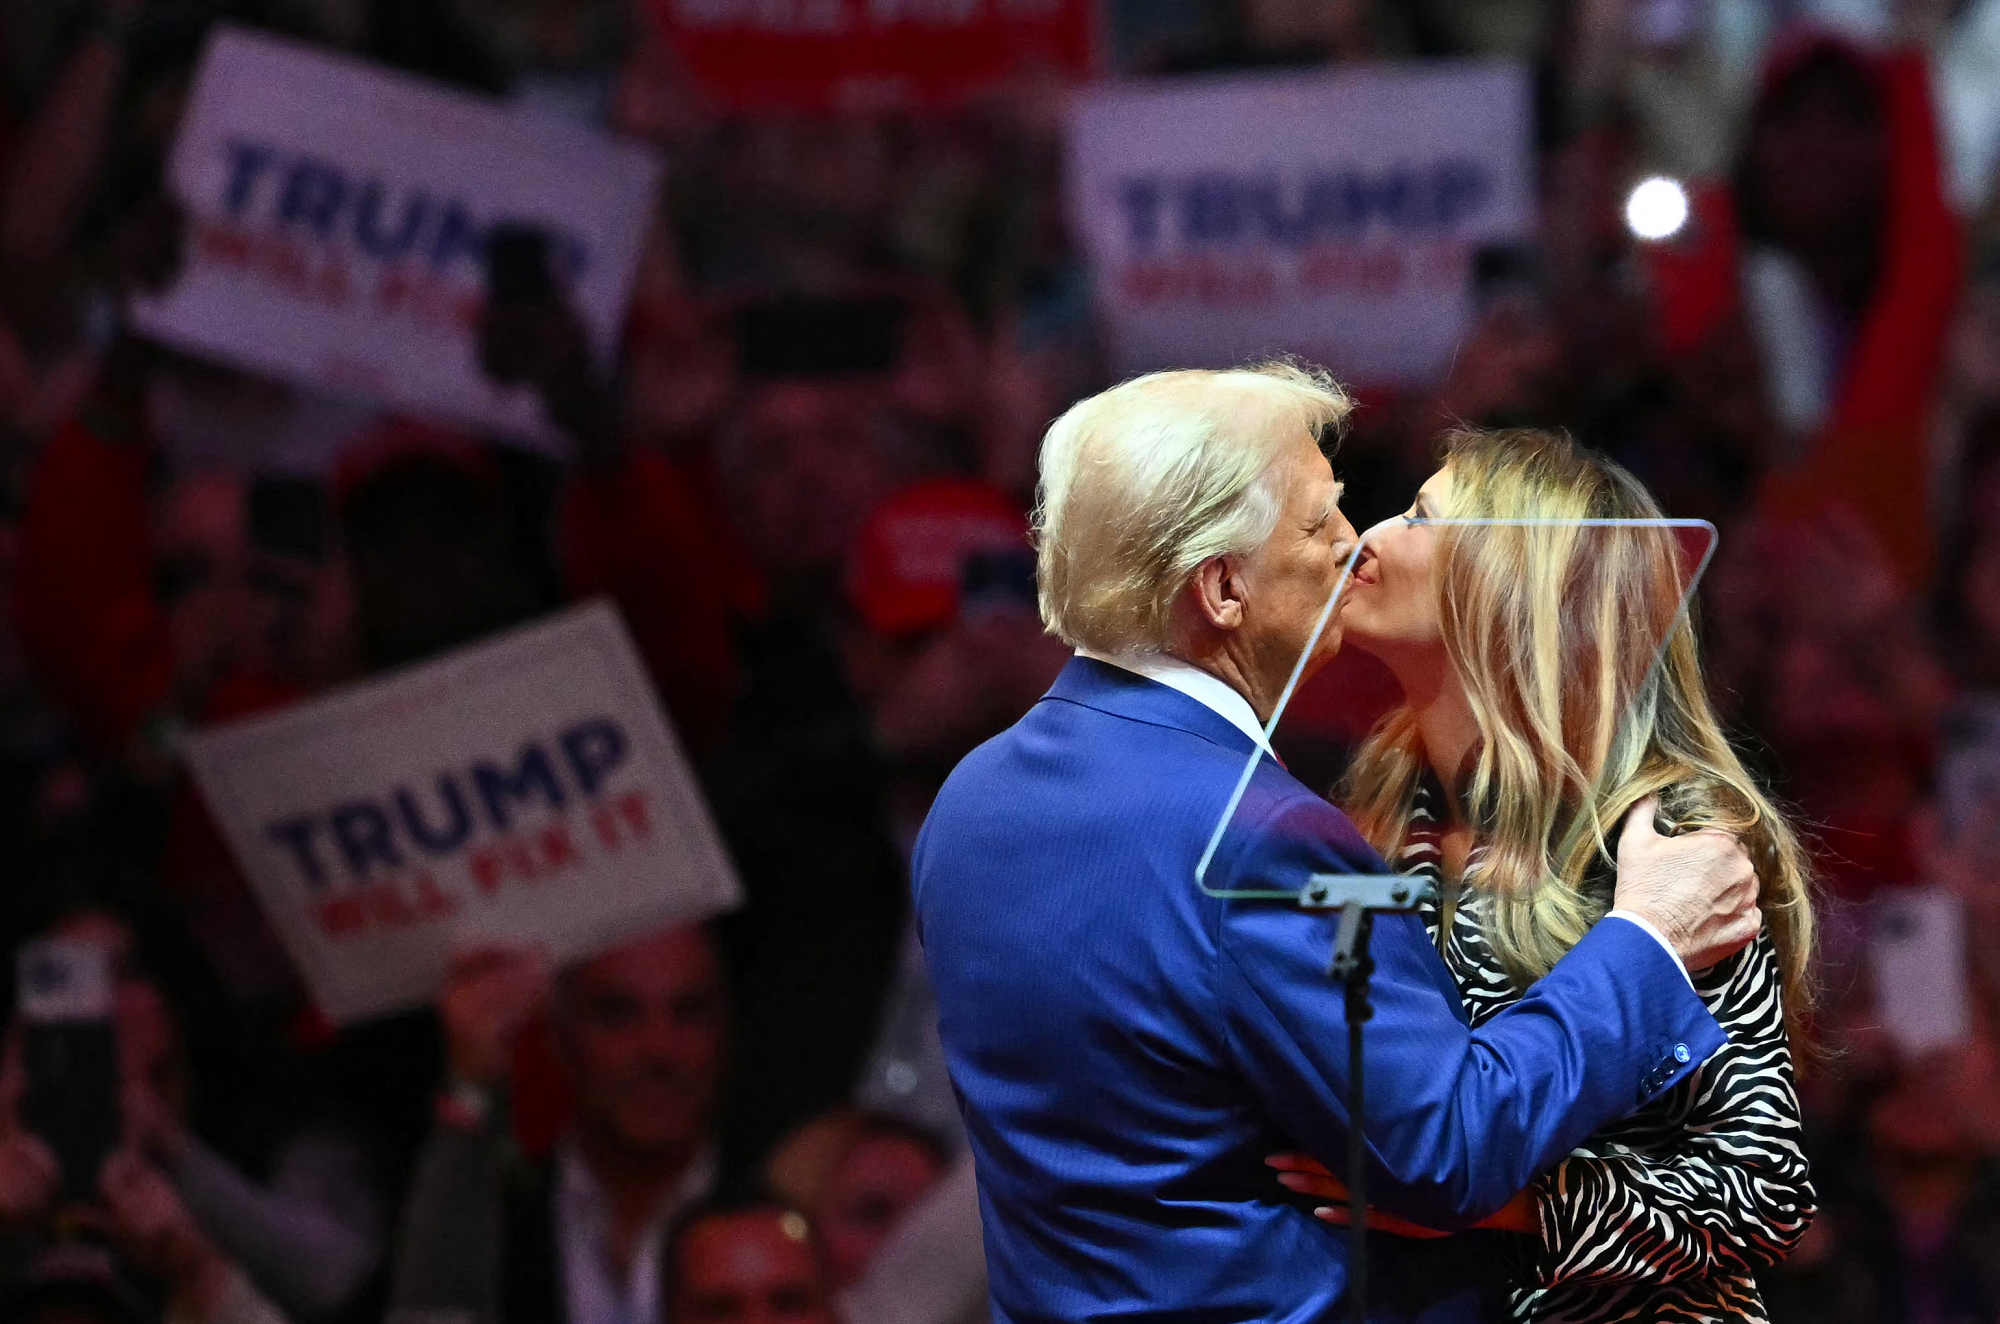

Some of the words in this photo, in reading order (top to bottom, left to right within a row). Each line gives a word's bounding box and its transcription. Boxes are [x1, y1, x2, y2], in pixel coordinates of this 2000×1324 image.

[1119, 158, 1491, 250] TRUMP
[268, 715, 630, 885] TRUMP
[316, 868, 460, 936] WILL
[469, 824, 578, 893] FIX
[592, 790, 652, 852] IT
